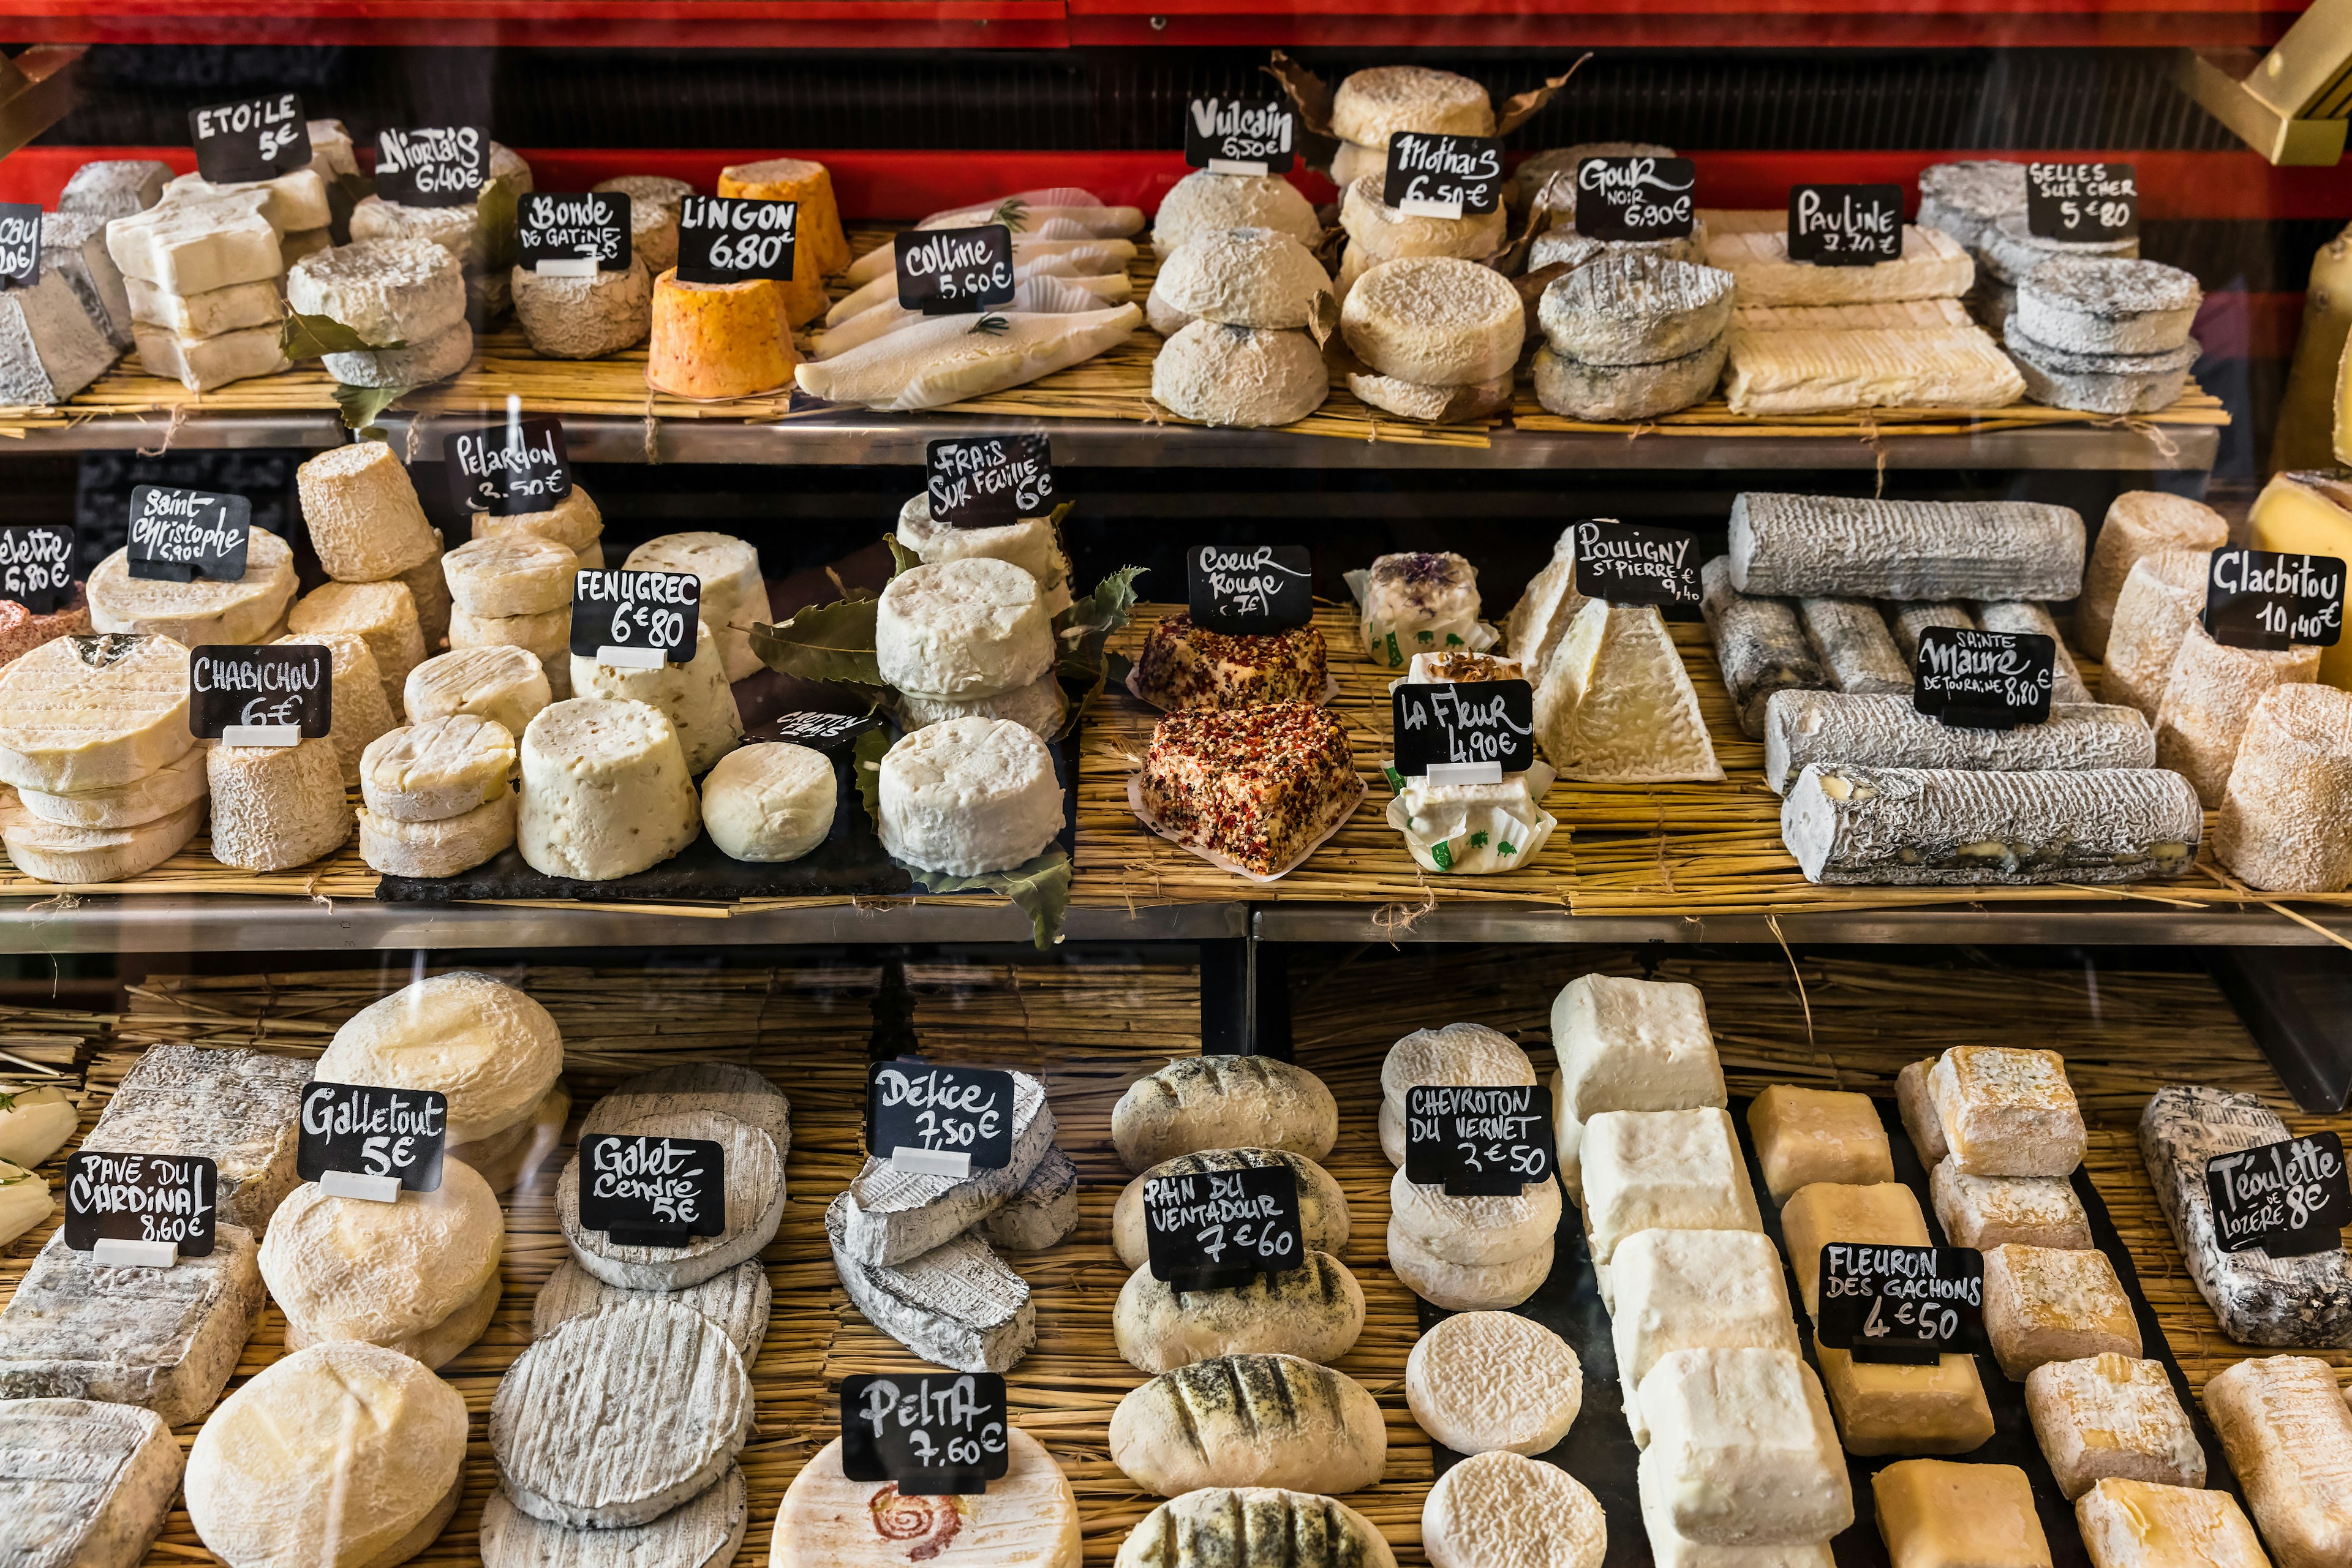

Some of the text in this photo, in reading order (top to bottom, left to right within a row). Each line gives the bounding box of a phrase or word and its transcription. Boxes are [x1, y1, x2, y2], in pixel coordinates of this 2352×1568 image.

[259, 123, 298, 160] 5€
[1191, 98, 1292, 153] Vulcain
[1222, 137, 1279, 160] 6,50€
[415, 164, 483, 192] 6,40€
[2029, 162, 2107, 184] SELLES
[2041, 180, 2138, 197] SUR CHER
[529, 193, 614, 230] Bonde
[1624, 195, 1691, 226] 6,90€
[521, 229, 541, 248] DE
[144, 489, 215, 518] Saint
[929, 475, 971, 516] SUR
[1016, 473, 1052, 510] 6€
[132, 507, 245, 560] Christophe
[578, 571, 698, 605] FENUGREC
[2256, 601, 2340, 639] 10,40€
[194, 657, 319, 692] CHABICHOU
[1920, 638, 2031, 680] Maure
[1402, 694, 1428, 729] LA
[1449, 723, 1517, 763] 4,90€
[875, 1069, 995, 1112] Délice
[1412, 1086, 1531, 1115] CHEVROTON
[916, 1110, 1001, 1150] 7,50€
[1410, 1115, 1542, 1142] DU VERNET
[151, 1159, 189, 1185] DU
[361, 1136, 416, 1177] 5€
[594, 1137, 696, 1179] Galet
[594, 1169, 703, 1202] Cendré
[1210, 1174, 1245, 1201] DU
[2266, 1192, 2281, 1204] DE
[652, 1197, 699, 1223] 5€
[1152, 1196, 1284, 1232] VENTADOUR
[2286, 1184, 2330, 1230] 8€
[140, 1214, 204, 1242] 8,60€
[1828, 1246, 1937, 1276] FLEURON
[1827, 1278, 1981, 1306] DES GACHONS
